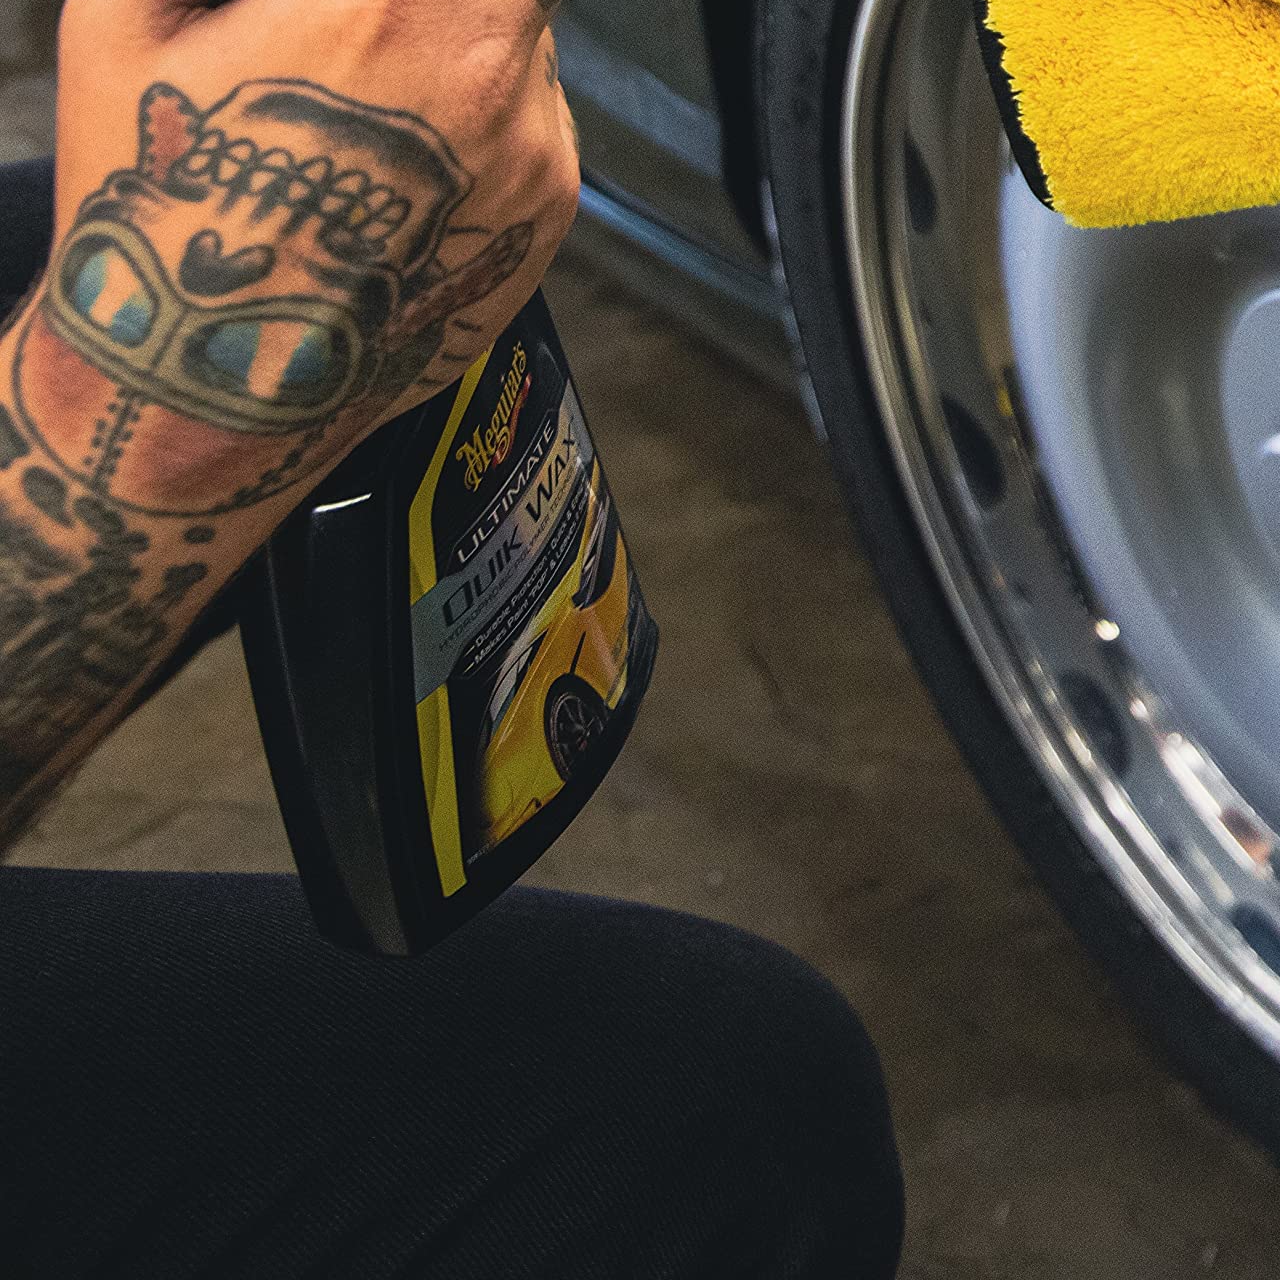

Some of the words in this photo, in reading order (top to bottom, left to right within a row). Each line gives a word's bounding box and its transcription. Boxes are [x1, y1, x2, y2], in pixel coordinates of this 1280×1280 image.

[456, 340, 527, 493] Meguiar's
[440, 523, 523, 628] QUIK
[524, 416, 575, 524] WAX
[457, 419, 554, 564] ULTIMATE
[512, 513, 550, 568] POLYMER
[473, 626, 506, 663] Makes
[506, 597, 528, 628] Paint
[474, 604, 510, 647] Durable
[511, 555, 547, 607] Protection
[550, 521, 567, 549] Quick
